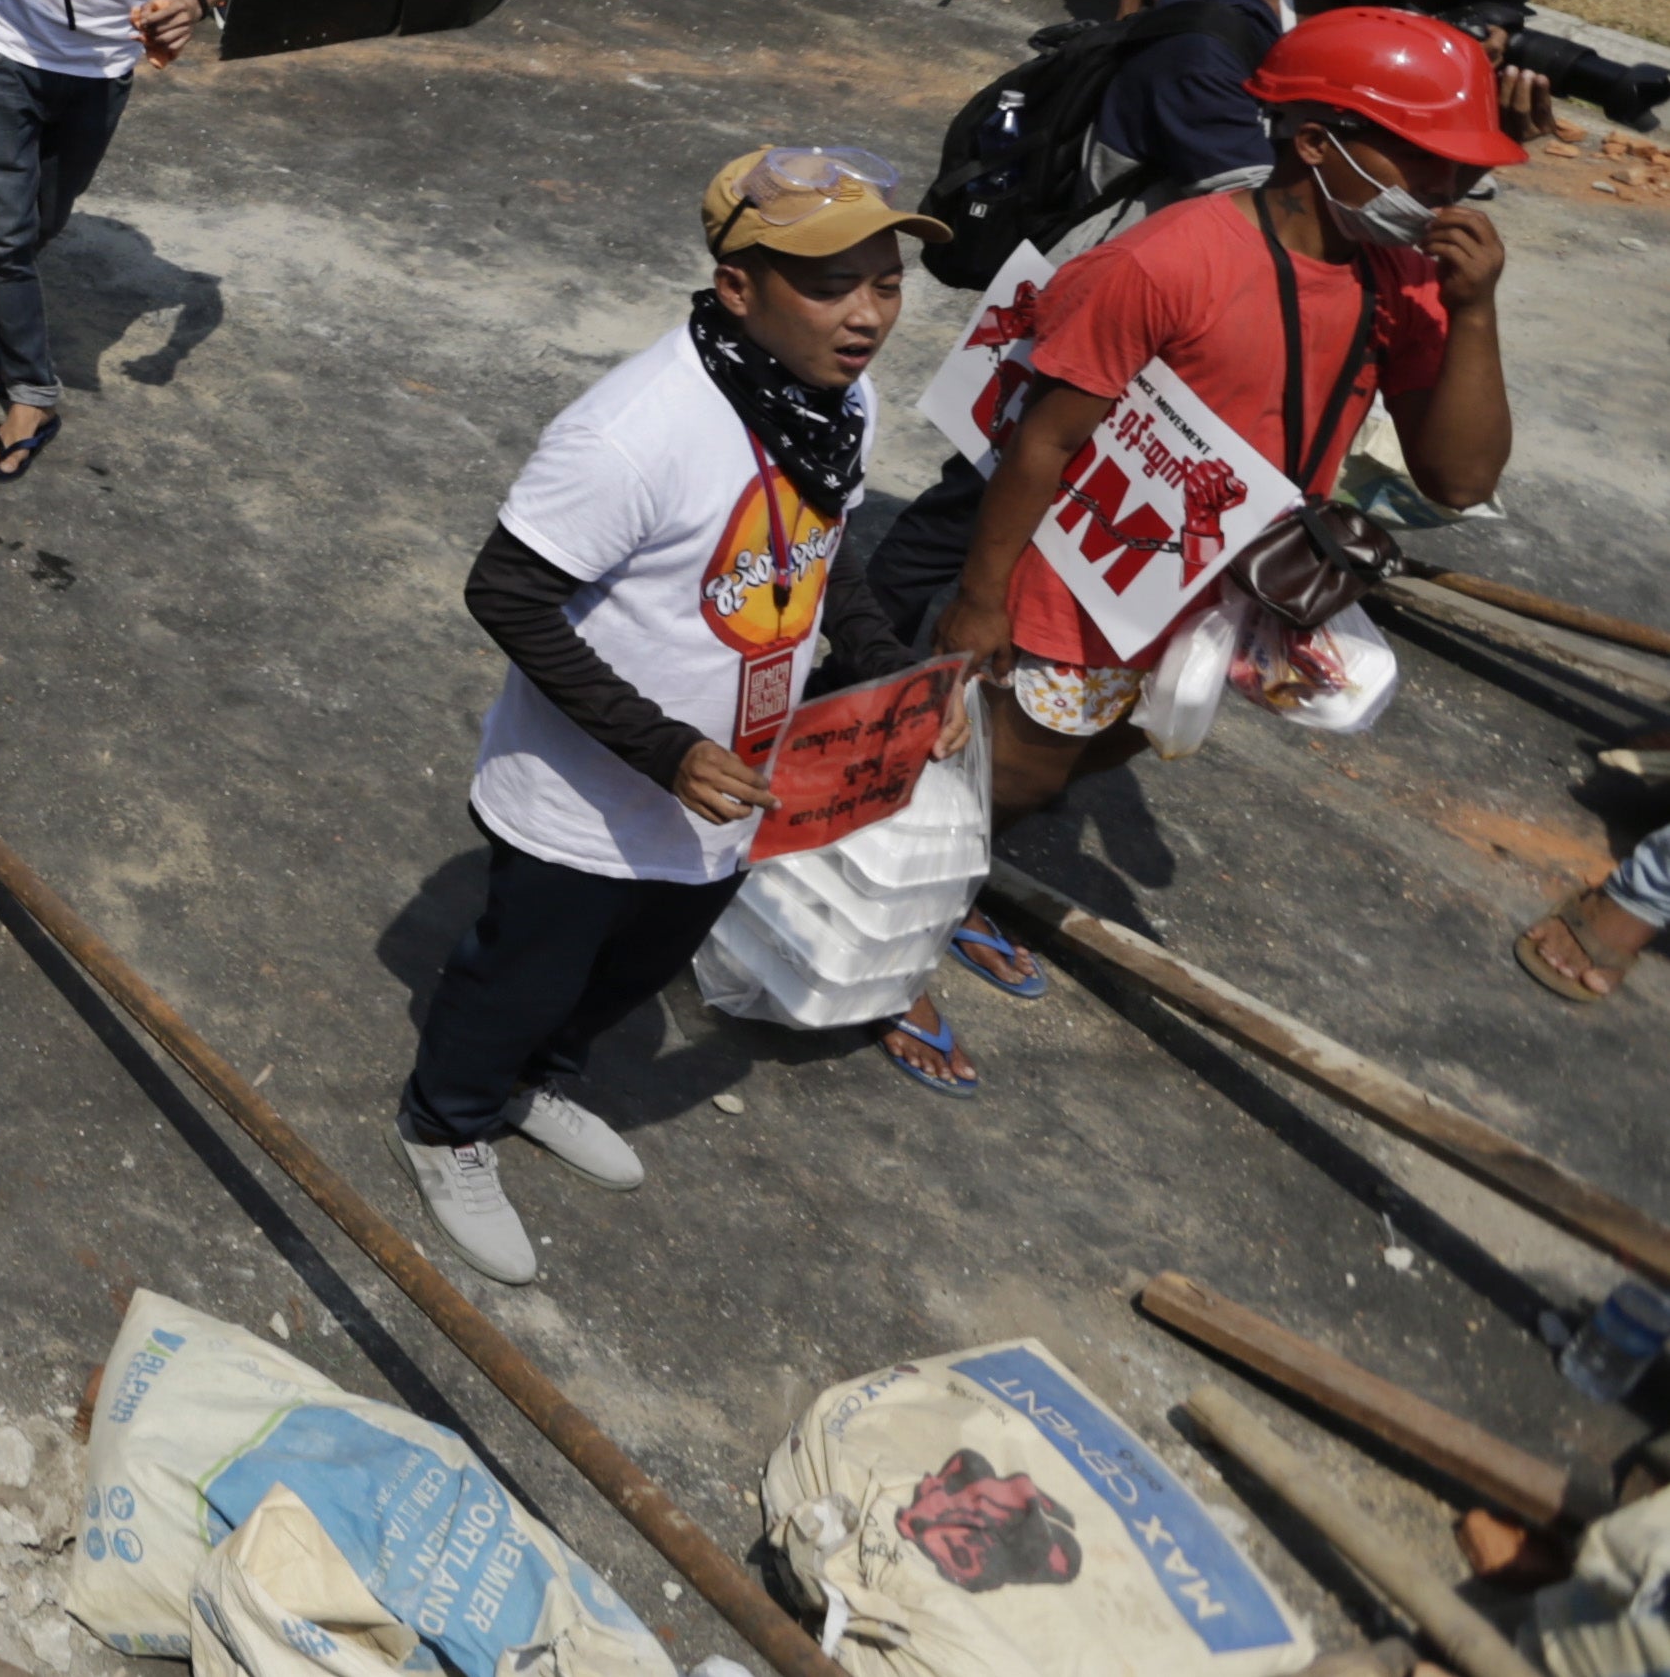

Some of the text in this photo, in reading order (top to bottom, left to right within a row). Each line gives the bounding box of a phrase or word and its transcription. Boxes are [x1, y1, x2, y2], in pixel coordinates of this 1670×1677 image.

[1154, 395, 1213, 456] MOVEMENT
[111, 1350, 168, 1424] ALPHA
[410, 1467, 448, 1506] CEM
[987, 1375, 1228, 1620] MAX CEMENT
[419, 1477, 500, 1639] PORTLAND
[462, 1519, 536, 1634] REMIER
